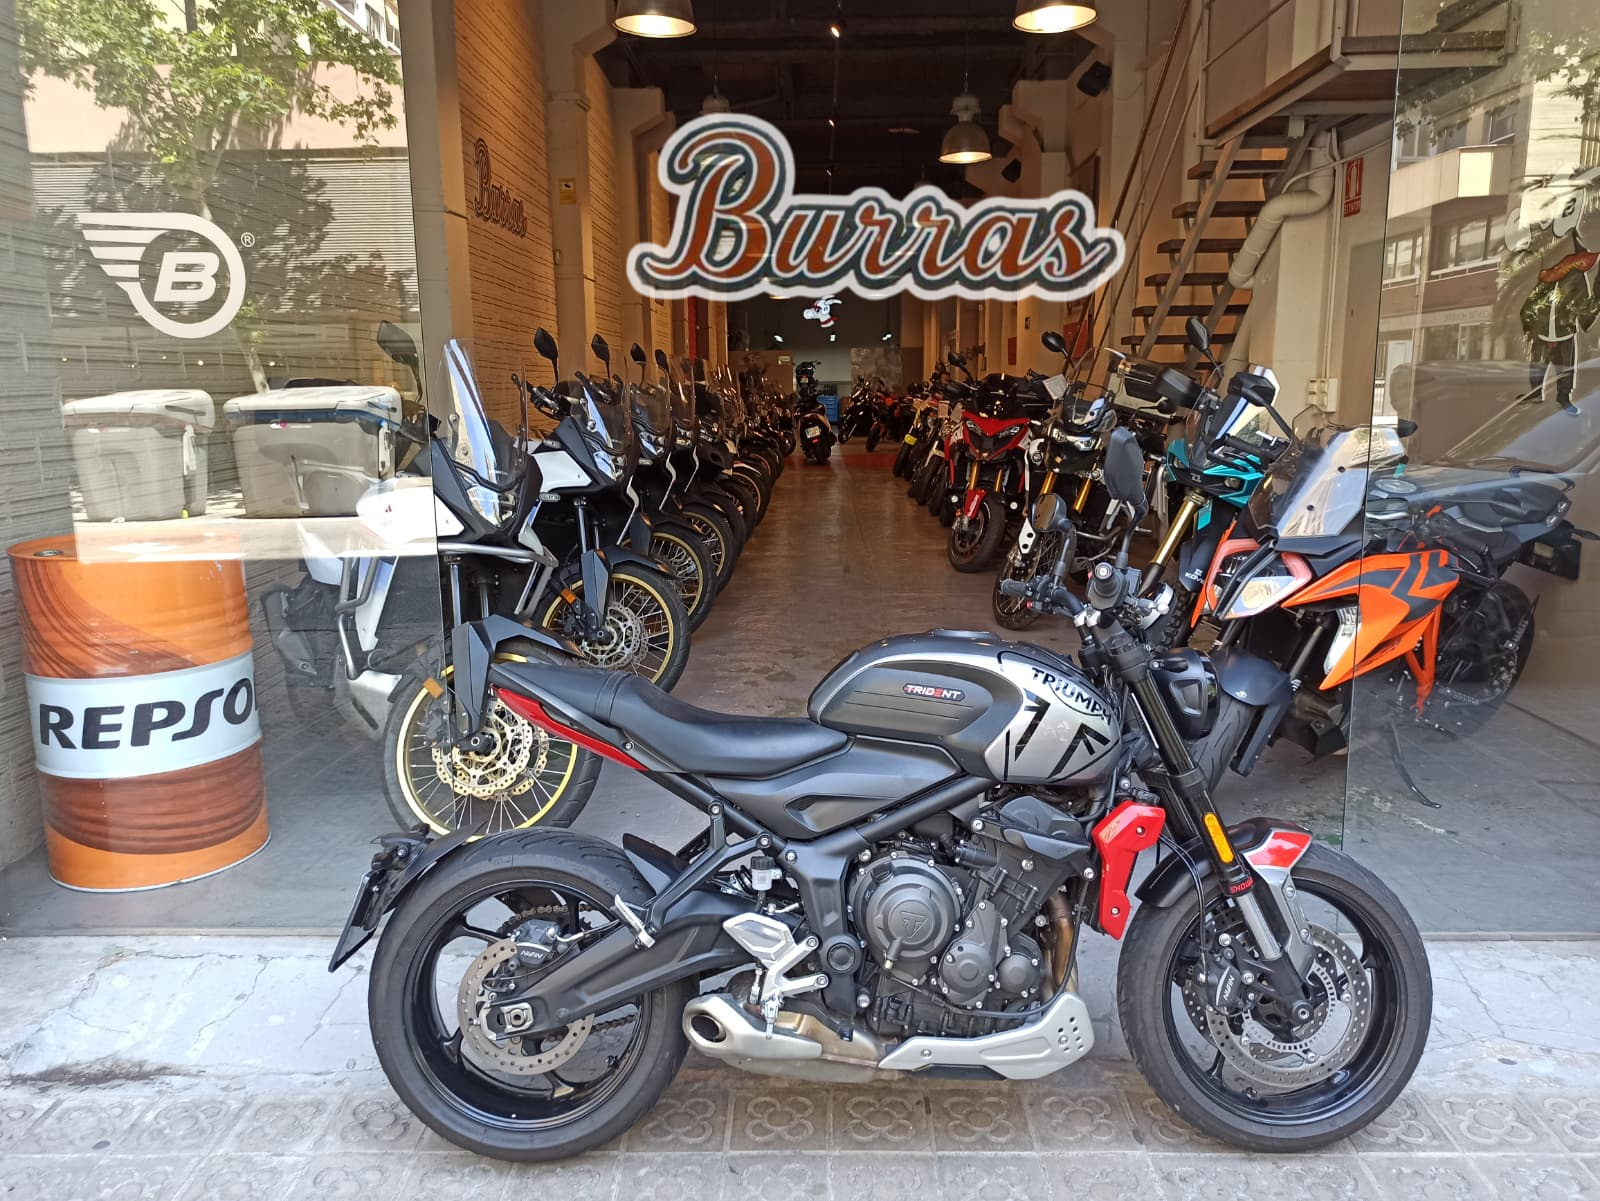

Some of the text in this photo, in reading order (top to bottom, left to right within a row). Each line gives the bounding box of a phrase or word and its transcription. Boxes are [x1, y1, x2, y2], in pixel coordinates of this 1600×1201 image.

[39, 671, 258, 750] REPSO
[904, 684, 961, 699] TRIDENT
[1032, 667, 1111, 725] TRIUMPH
